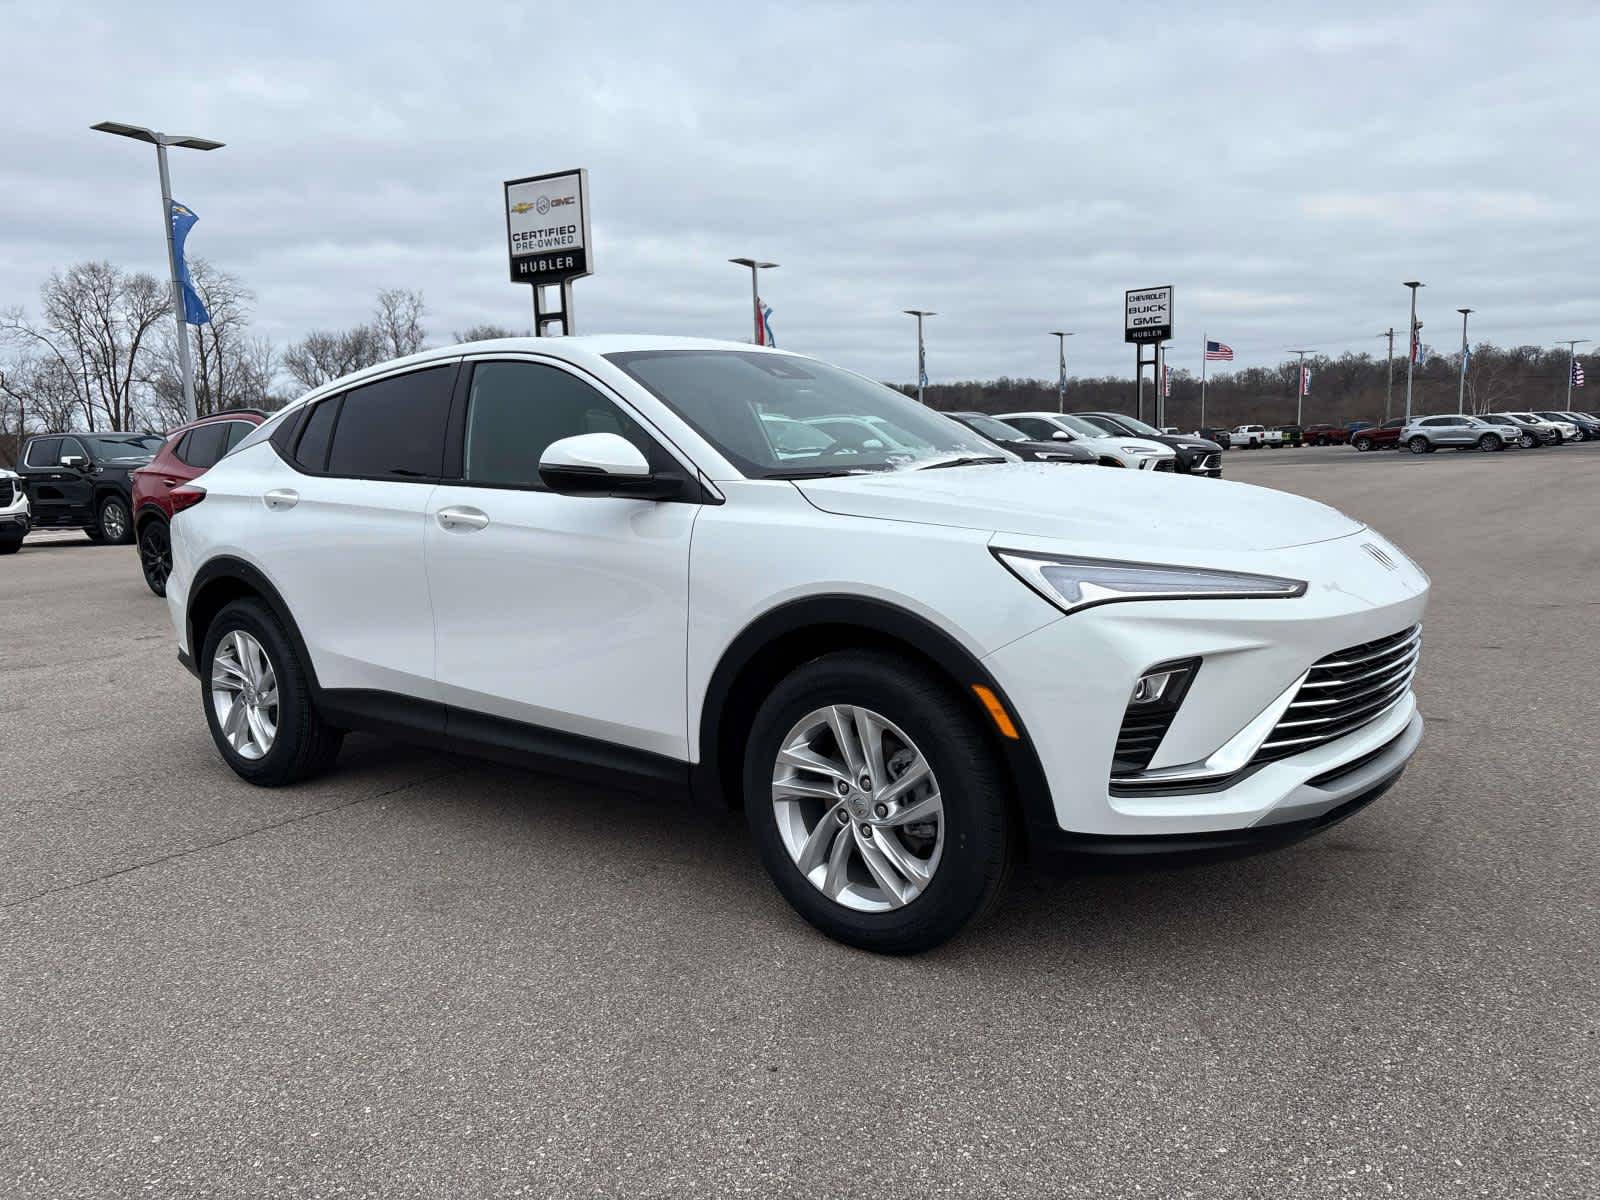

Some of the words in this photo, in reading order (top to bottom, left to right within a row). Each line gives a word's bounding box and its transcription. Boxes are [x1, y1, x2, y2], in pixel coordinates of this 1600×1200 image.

[551, 196, 575, 208] GMC
[512, 225, 576, 242] CERTIFIED
[516, 235, 574, 250] PRE-OWNED
[520, 257, 574, 273] HUBLER
[1128, 292, 1166, 302] CHEVROLET
[1128, 304, 1167, 314] BUICK
[1133, 316, 1162, 325] GMC
